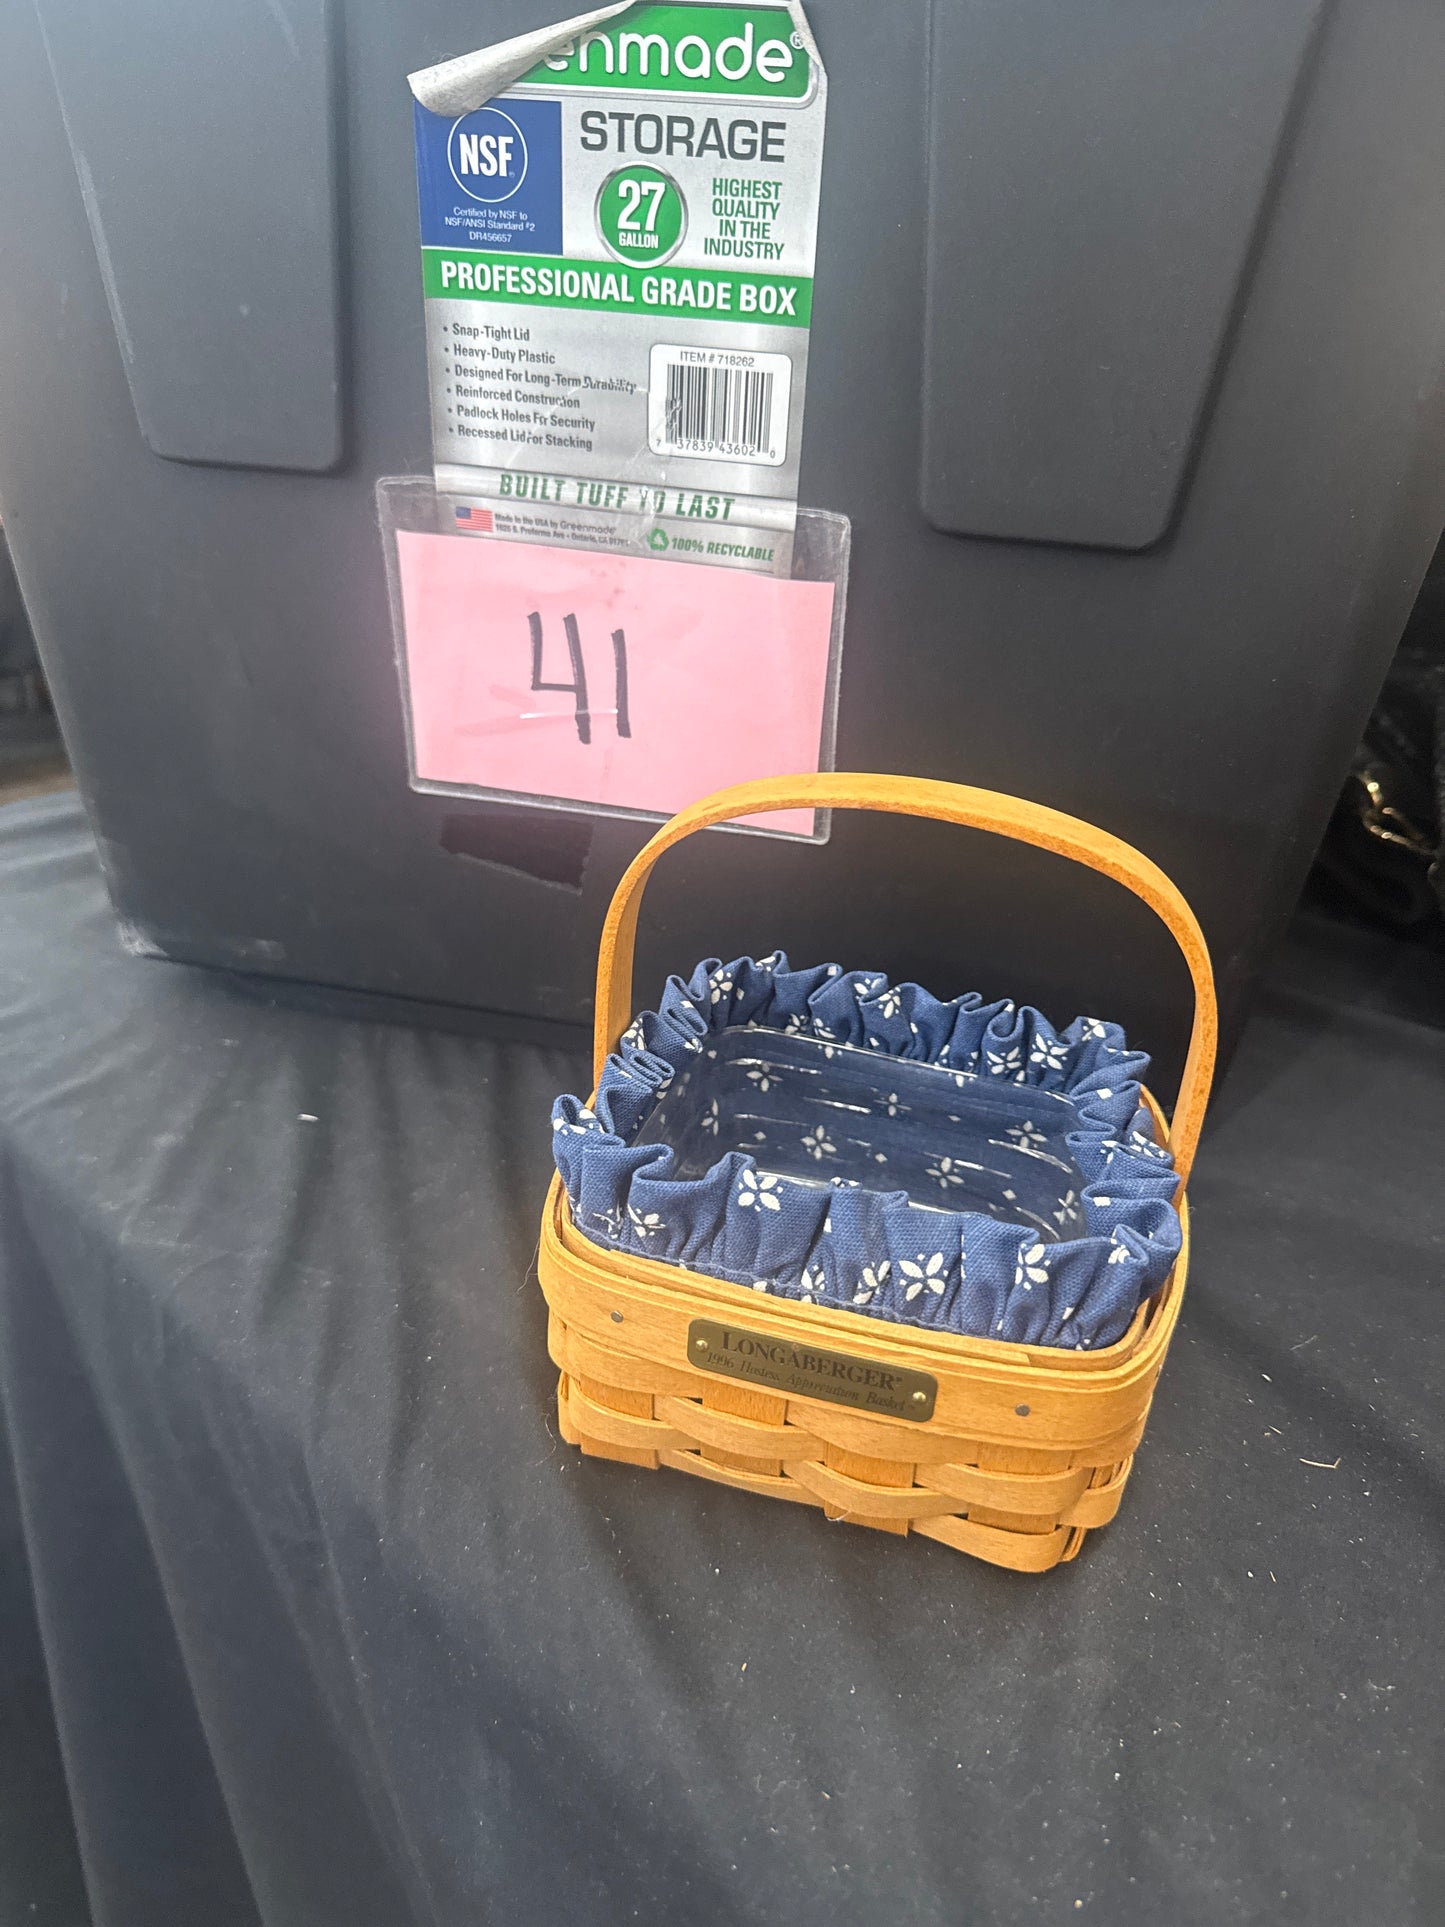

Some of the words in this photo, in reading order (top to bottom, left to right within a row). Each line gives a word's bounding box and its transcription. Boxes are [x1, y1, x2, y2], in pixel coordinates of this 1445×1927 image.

[579, 110, 787, 163] STORAGE
[711, 177, 783, 200] HIGHEST
[453, 206, 487, 218] Certified
[488, 209, 498, 220] by
[499, 210, 518, 220] NSF
[519, 211, 528, 220] to
[617, 179, 666, 232] 27
[711, 198, 781, 221] QUALITY
[444, 217, 486, 228] NSF/ANSI
[487, 220, 524, 231] Standard
[525, 222, 536, 232] #2
[718, 218, 738, 237] IN
[740, 220, 771, 240] THE
[618, 232, 660, 250] GALLON
[703, 238, 785, 260] INDUSTRY
[441, 260, 634, 303] PROFESSIONAL
[641, 278, 732, 311] GRADE
[738, 284, 798, 316] BOX
[452, 323, 512, 341] Snap-Tight
[513, 328, 530, 341] Lid
[453, 343, 516, 363] Heavy-Duty
[518, 350, 556, 365] Plastic
[679, 351, 706, 363] ITEM
[708, 353, 715, 363] #
[717, 354, 755, 368] 718262
[454, 364, 504, 381] Designed
[506, 370, 523, 382] For
[524, 370, 582, 387] Long-Term
[455, 384, 513, 401] Reinforced
[514, 391, 580, 408] Construction
[456, 404, 499, 420] Padlock
[501, 409, 531, 424] Holes
[550, 414, 596, 432] Security
[457, 424, 508, 441] Recessed
[510, 429, 526, 443] Lid
[545, 433, 593, 452] Stacking
[655, 439, 662, 447] 7
[677, 439, 714, 452] 37839
[719, 443, 756, 457] 43602
[769, 450, 776, 459] 0
[500, 474, 566, 502] BUILT
[576, 482, 629, 508] TUFF
[675, 493, 736, 521] LAST
[534, 517, 549, 527] USA
[671, 537, 705, 554] 100%
[705, 541, 775, 562] RECYCLABLE
[527, 610, 632, 745] 41
[706, 1351, 735, 1369] 1996
[739, 1360, 780, 1381] Hostess
[785, 1373, 860, 1401] Appreciation
